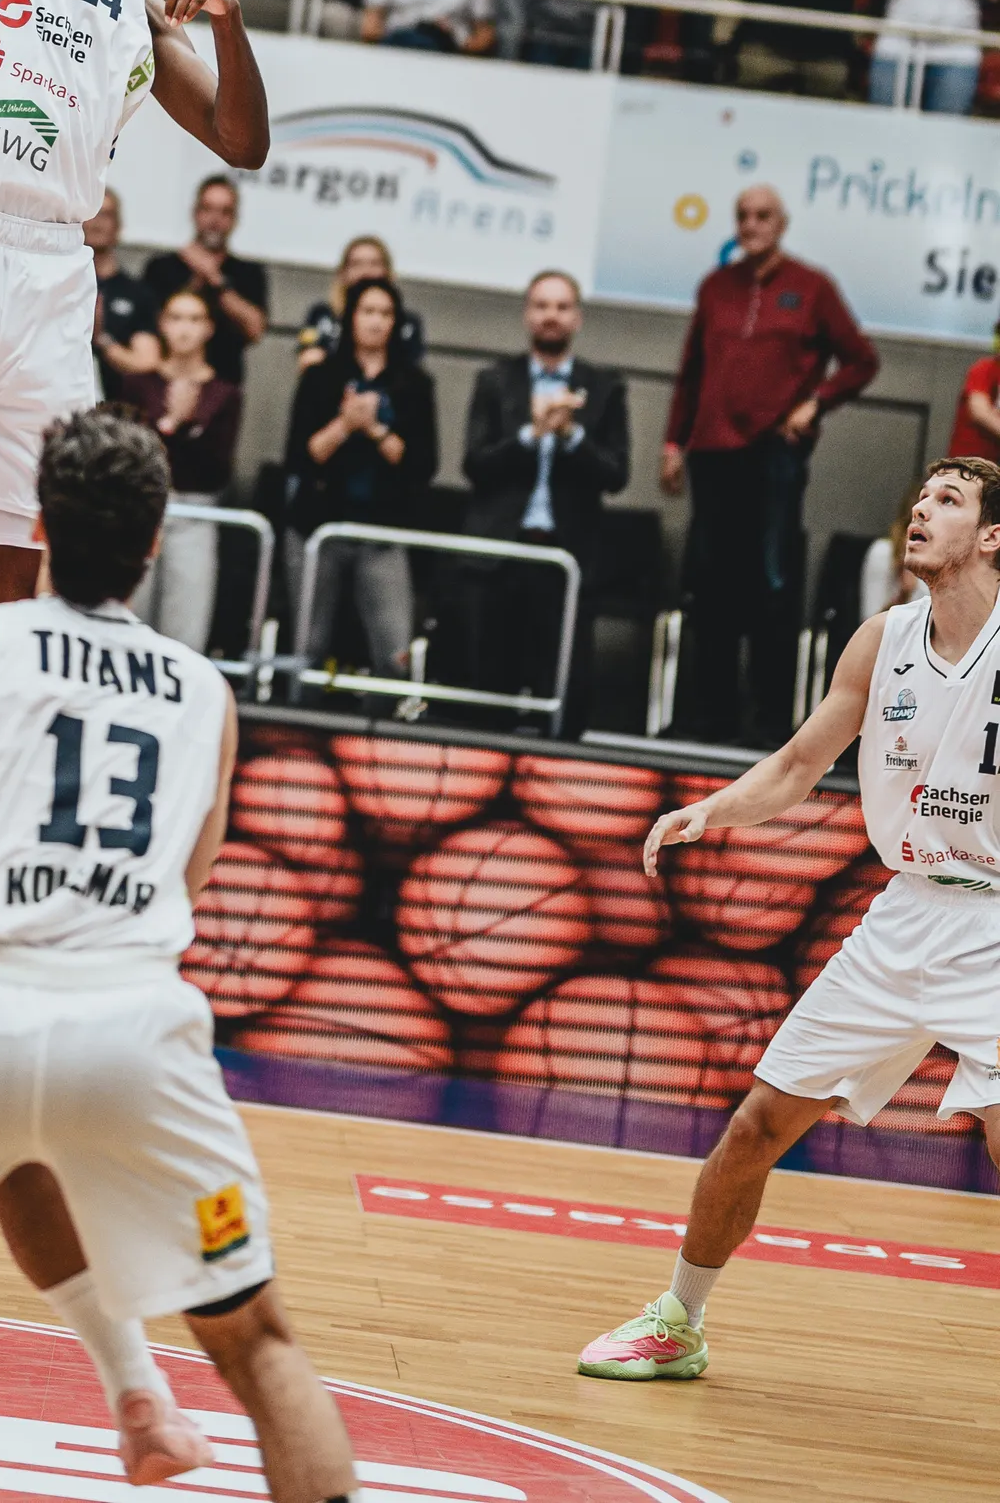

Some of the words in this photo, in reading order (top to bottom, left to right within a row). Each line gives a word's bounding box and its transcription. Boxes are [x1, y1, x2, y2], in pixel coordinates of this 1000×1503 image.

[35, 6, 93, 48] Sachen
[411, 187, 556, 240] Arena
[31, 629, 183, 704] TITANS
[884, 706, 916, 721] TITANS
[885, 753, 918, 770] Freiberger
[39, 711, 160, 857] 13
[922, 784, 990, 806] Sachsen
[921, 802, 983, 825] Energie
[918, 846, 996, 867] Sparkasse
